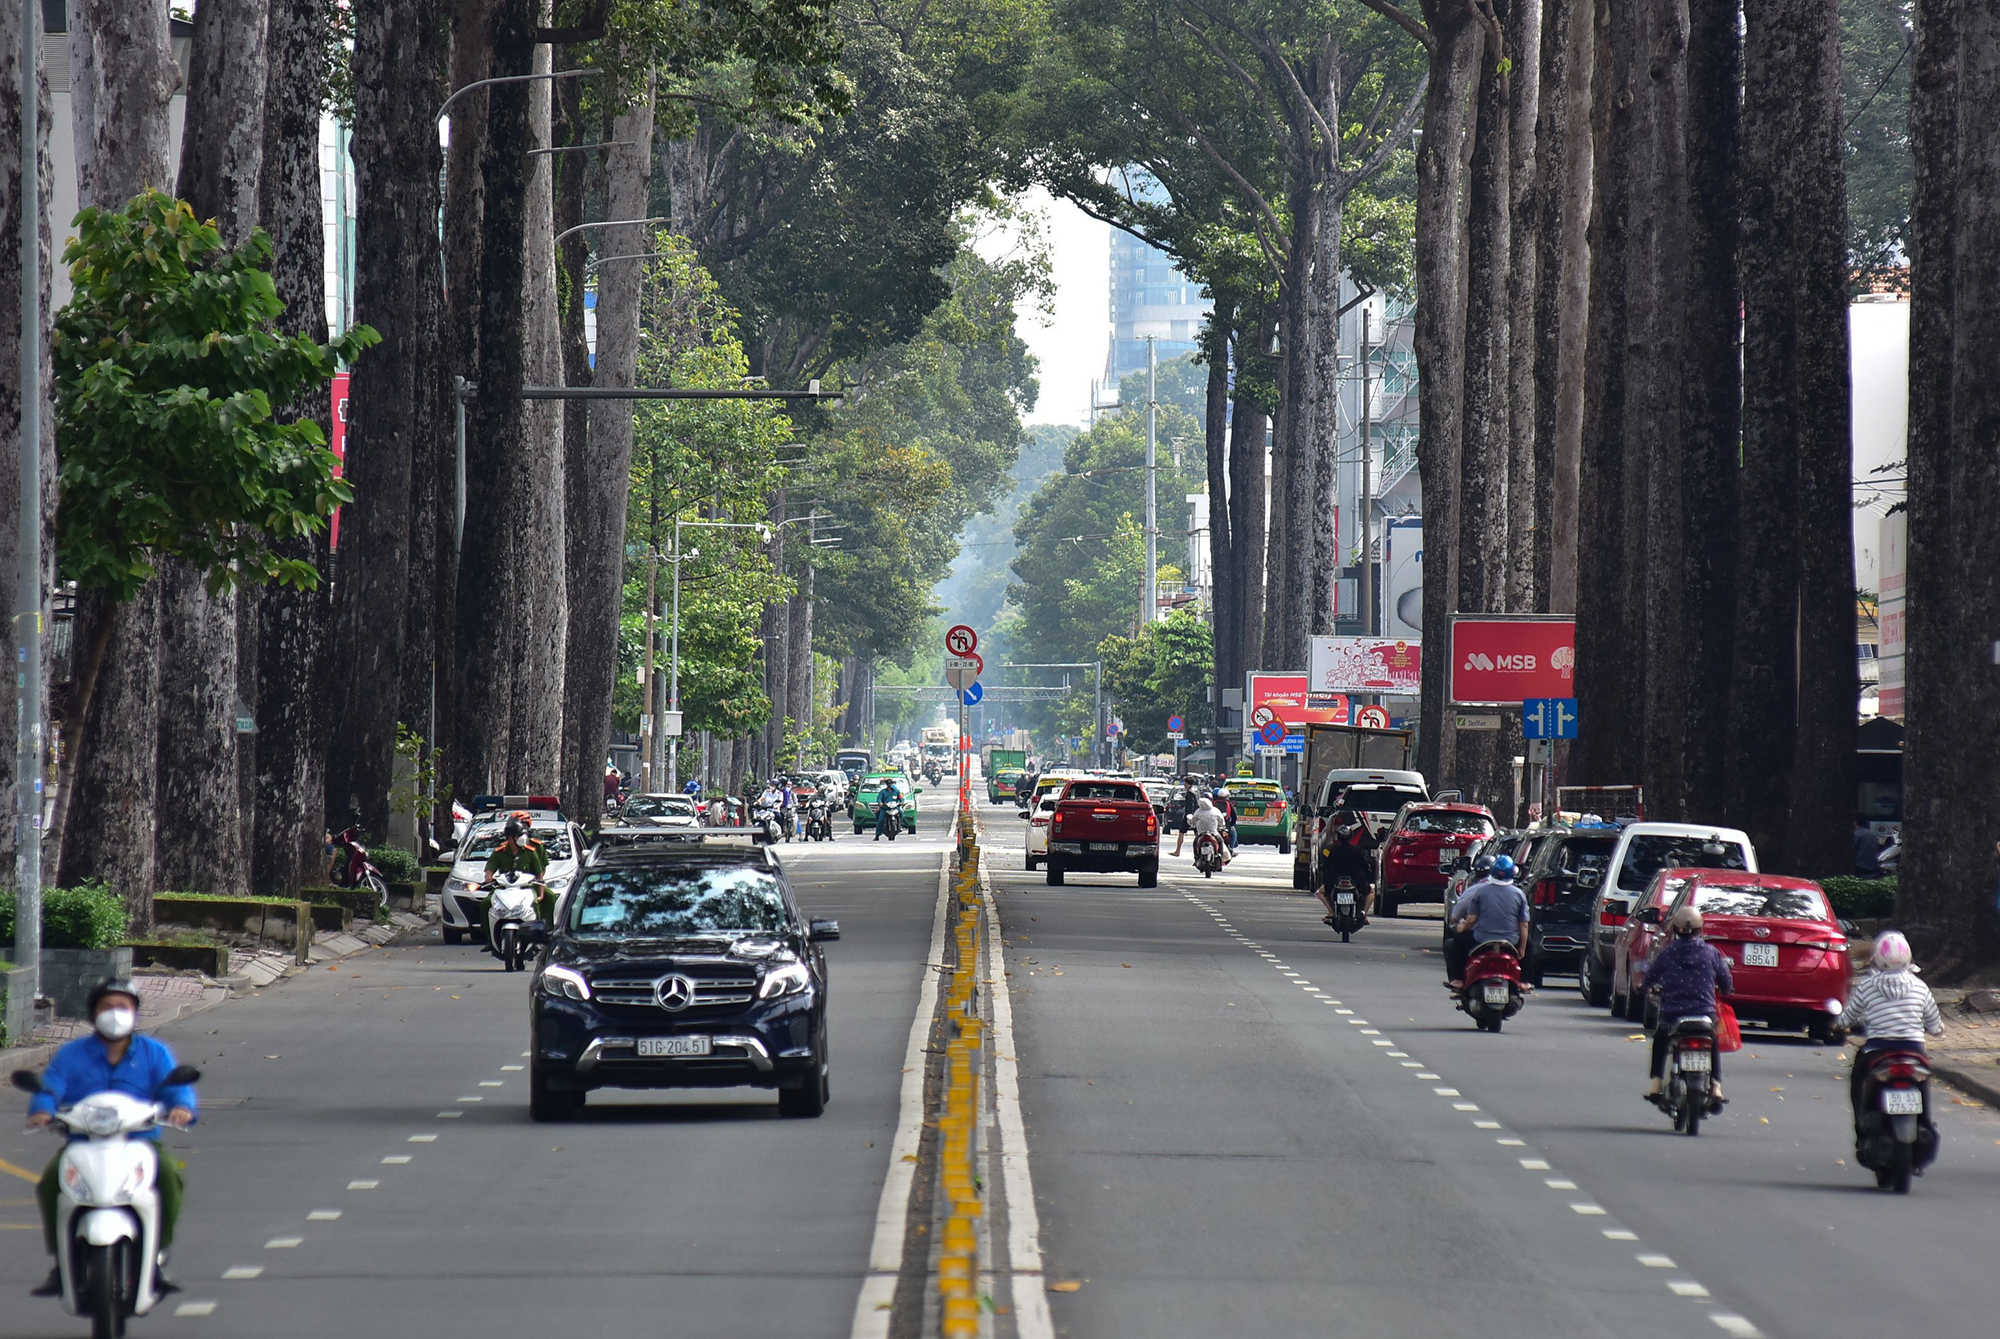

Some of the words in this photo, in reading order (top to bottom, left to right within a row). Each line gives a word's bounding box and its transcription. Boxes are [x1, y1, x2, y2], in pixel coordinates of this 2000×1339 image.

[1496, 654, 1537, 670] MSB
[1753, 944, 1771, 955] 51G
[1746, 954, 1775, 966] 995.41
[639, 1040, 706, 1055] 51G-204.51
